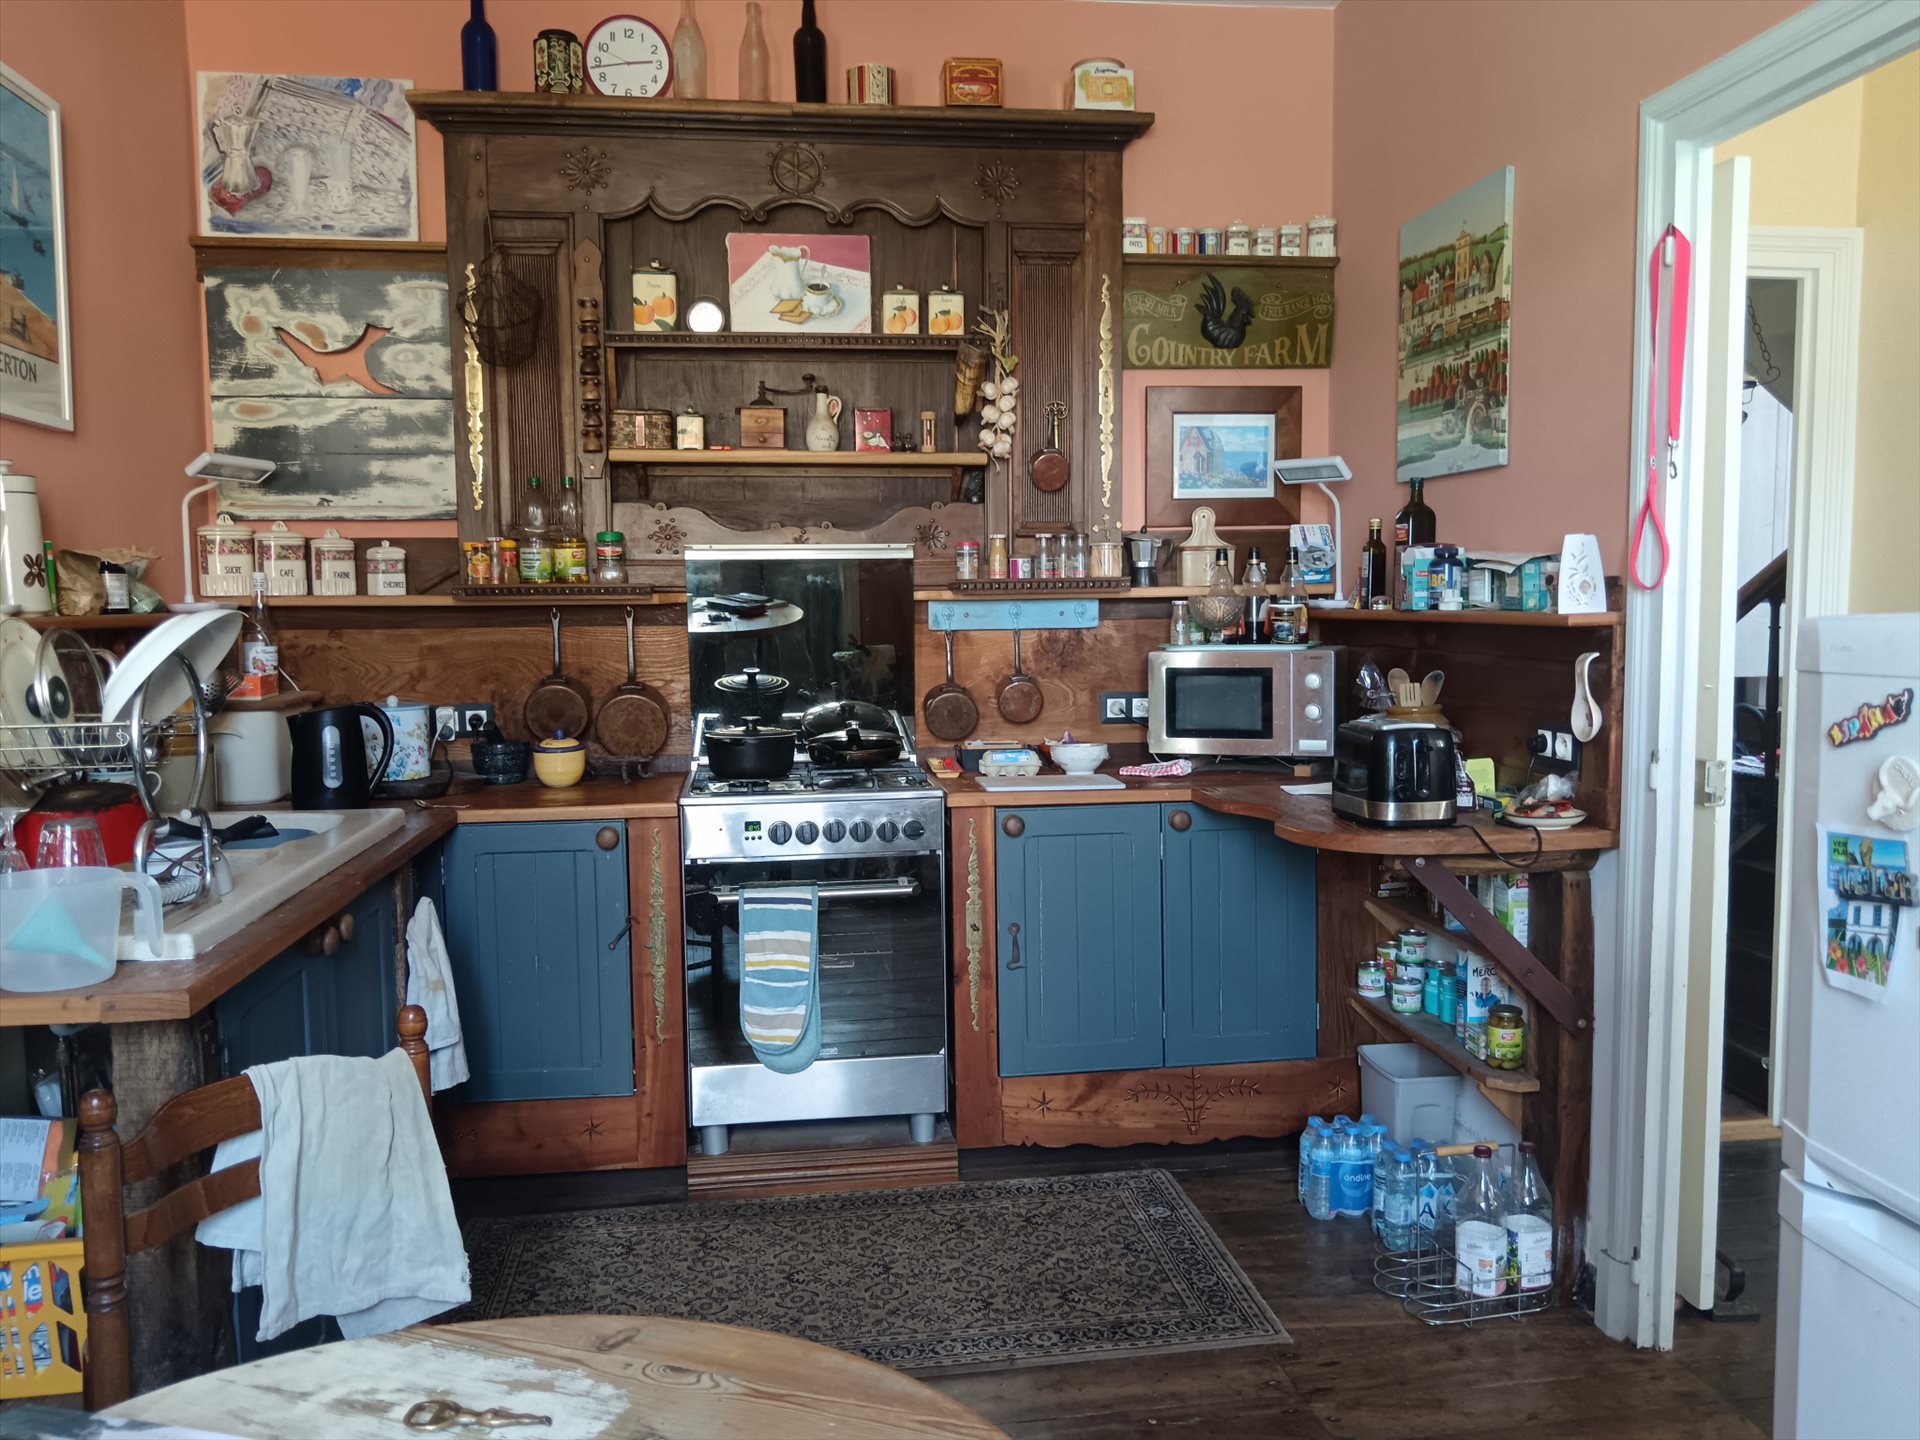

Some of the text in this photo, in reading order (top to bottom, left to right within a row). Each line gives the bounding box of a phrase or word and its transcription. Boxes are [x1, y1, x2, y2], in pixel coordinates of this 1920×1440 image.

[610, 32, 615, 42] 11
[624, 28, 634, 39] 12
[598, 42, 609, 53] 10
[650, 44, 658, 55] 2
[594, 56, 602, 67] 9
[655, 60, 663, 70] 3
[599, 72, 607, 82] 8
[651, 75, 658, 84] 4
[610, 83, 618, 93] 7
[625, 88, 633, 97] 6
[640, 85, 648, 95] 5
[1127, 294, 1177, 318] FRESH MILK
[1263, 305, 1284, 318] FREE
[1285, 295, 1311, 315] RANGE
[1243, 322, 1330, 366] FARM
[224, 566, 242, 575] SUCRE
[333, 571, 351, 579] FARINE
[1343, 1173, 1372, 1183] ondine
